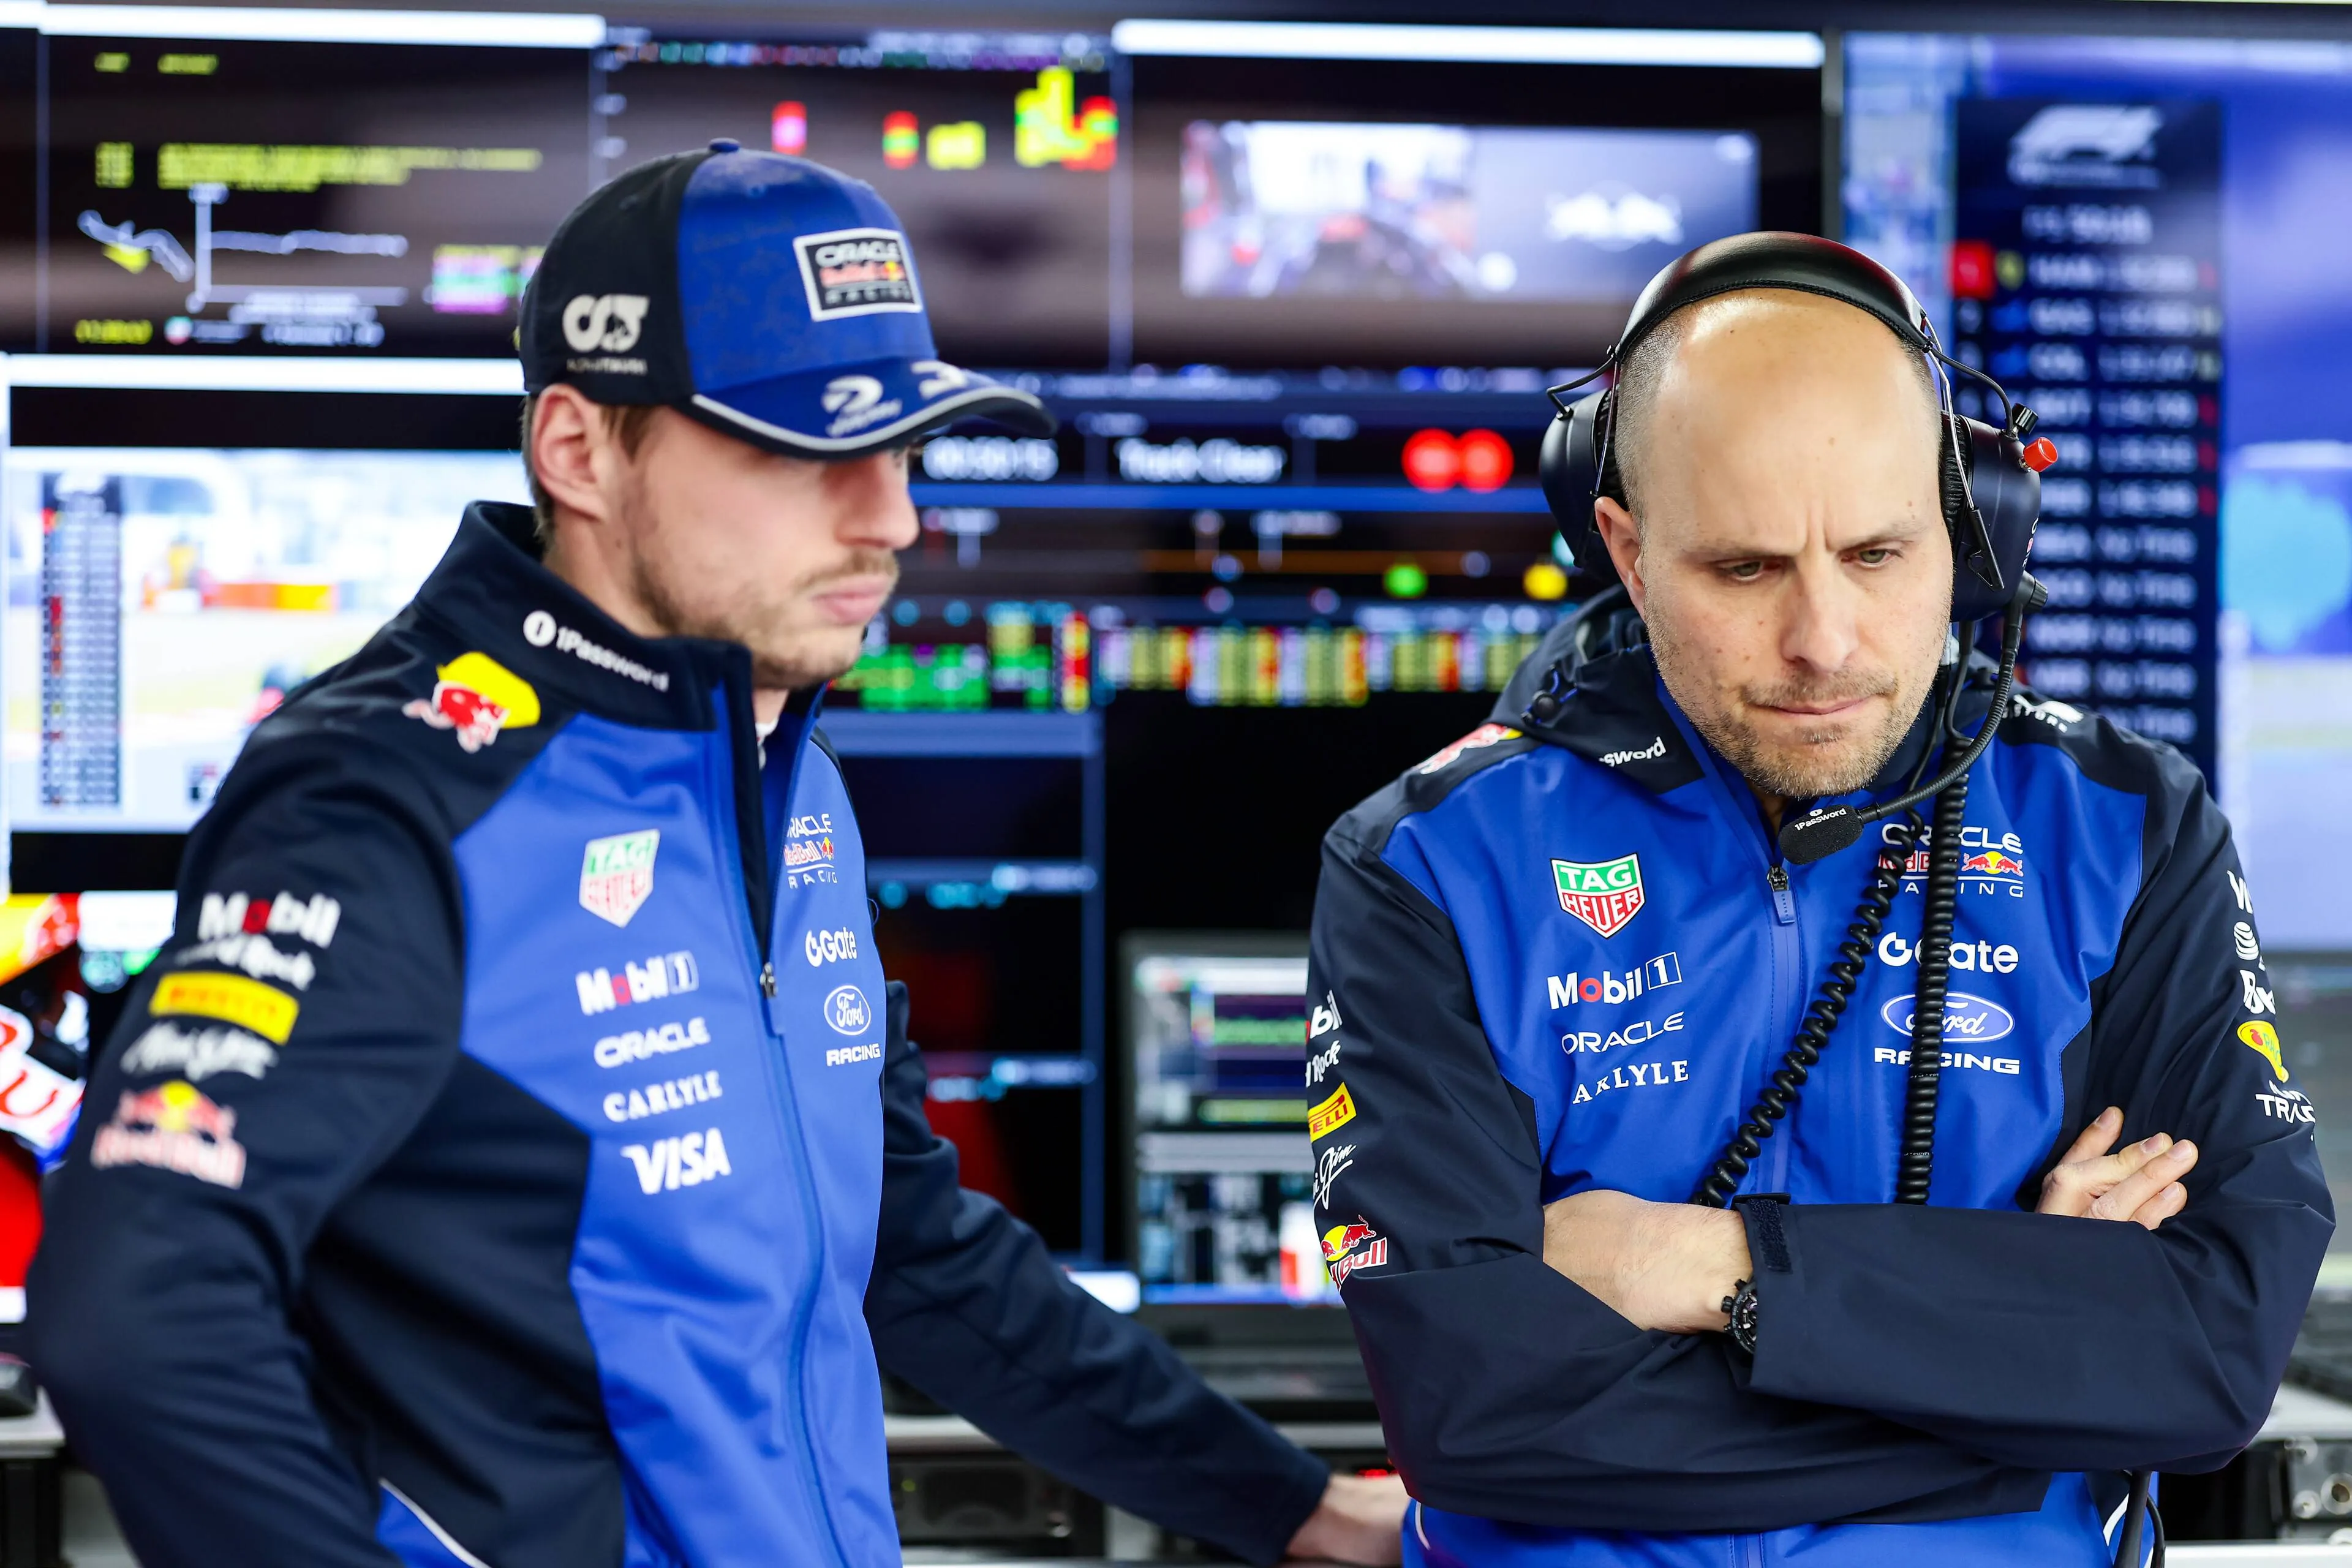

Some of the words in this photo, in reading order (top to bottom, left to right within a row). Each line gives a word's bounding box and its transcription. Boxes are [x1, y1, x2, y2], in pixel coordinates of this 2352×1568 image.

[1598, 736, 1666, 767] sword
[1794, 808, 1847, 831] 1Password
[1882, 823, 2024, 854] ORCLE
[1560, 864, 1633, 891] TAG
[1878, 880, 2024, 898] AING
[1564, 889, 1639, 931] HEUER
[1914, 939, 2019, 974] ate
[1547, 967, 1643, 1010] Mobil
[836, 992, 865, 1028] Ford
[1305, 989, 1343, 1044] bil
[594, 1016, 710, 1068] ORACLE
[1562, 1011, 1684, 1055] ORACLE
[826, 1043, 881, 1066] RACING
[603, 1071, 723, 1122] CARLYLE
[1572, 1060, 1689, 1105] ARLYLE
[1313, 1103, 1348, 1133] ELLI
[621, 1128, 732, 1195] VISA
[1338, 1236, 1388, 1285] Bull
